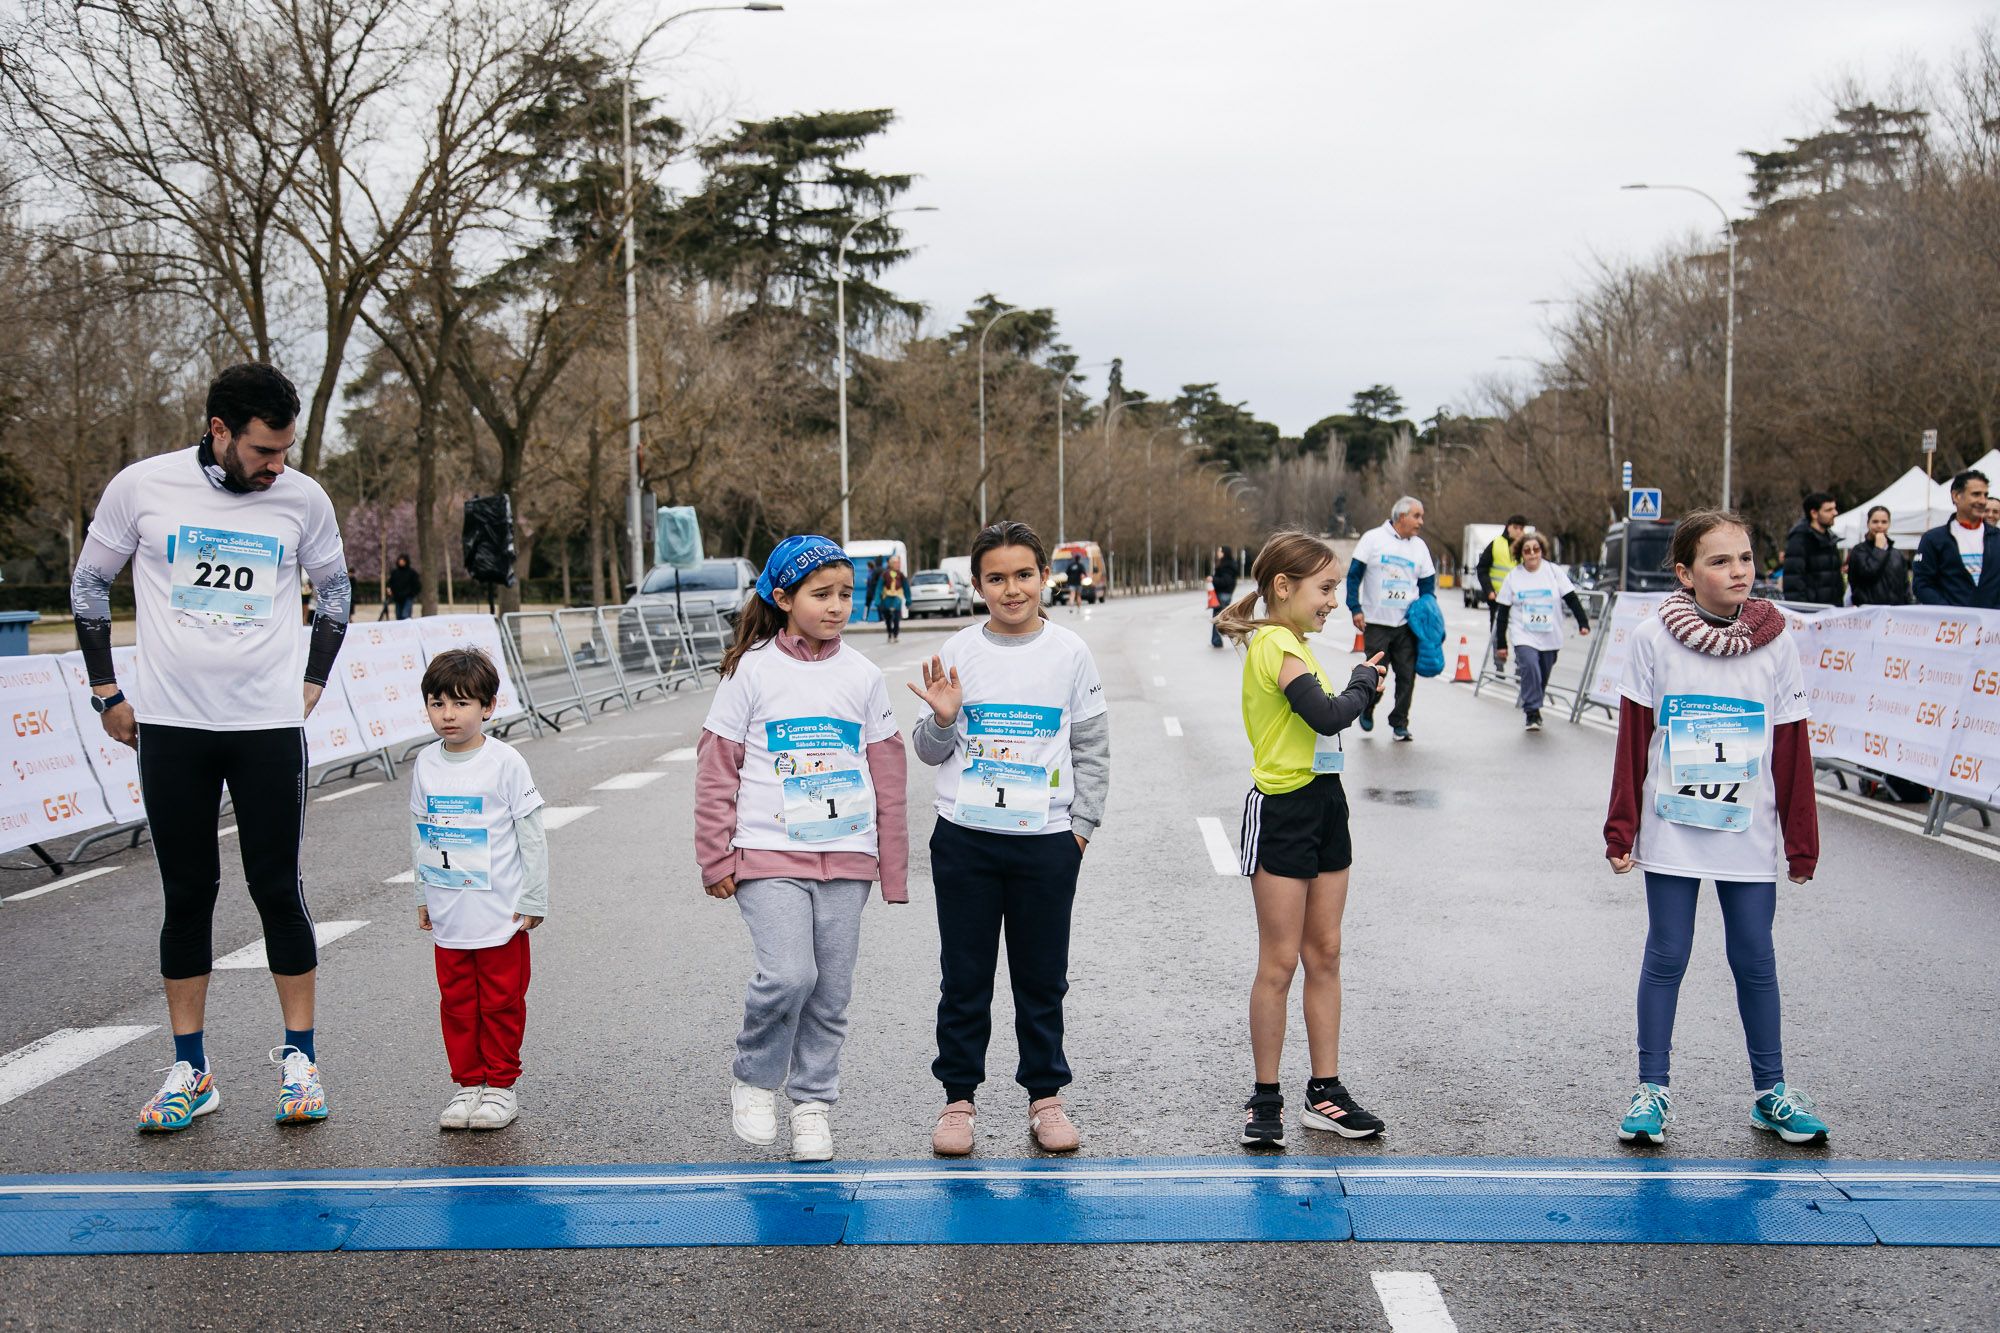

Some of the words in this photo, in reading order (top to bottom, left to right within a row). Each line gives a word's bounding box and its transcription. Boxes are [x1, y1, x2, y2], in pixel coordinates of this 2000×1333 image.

[200, 534, 228, 544] Carrera
[230, 538, 263, 548] Solidaria
[193, 562, 254, 591] 220
[1388, 591, 1406, 600] 262
[1530, 615, 1548, 623] 263
[1935, 620, 1967, 644] GSK
[1820, 648, 1855, 672] GSK
[1884, 656, 1911, 681] GSK
[979, 710, 1007, 719] Carrera
[1008, 711, 1043, 721] Solidaria
[1680, 701, 1711, 710] Carrera
[1712, 702, 1746, 713] Solidaria
[1916, 702, 1947, 728] GSK
[13, 709, 54, 738] GSK
[787, 725, 817, 733] Carrera
[1808, 720, 1837, 745] GSK
[1714, 742, 1727, 763] 1
[1864, 732, 1889, 758] GSK
[985, 764, 1004, 772] Carrera
[1004, 767, 1026, 775] Solidaria
[1949, 754, 1984, 783] GSK
[43, 791, 84, 822] GSK
[995, 787, 1007, 808] 1
[826, 798, 838, 819] 1
[441, 851, 451, 869] 1
